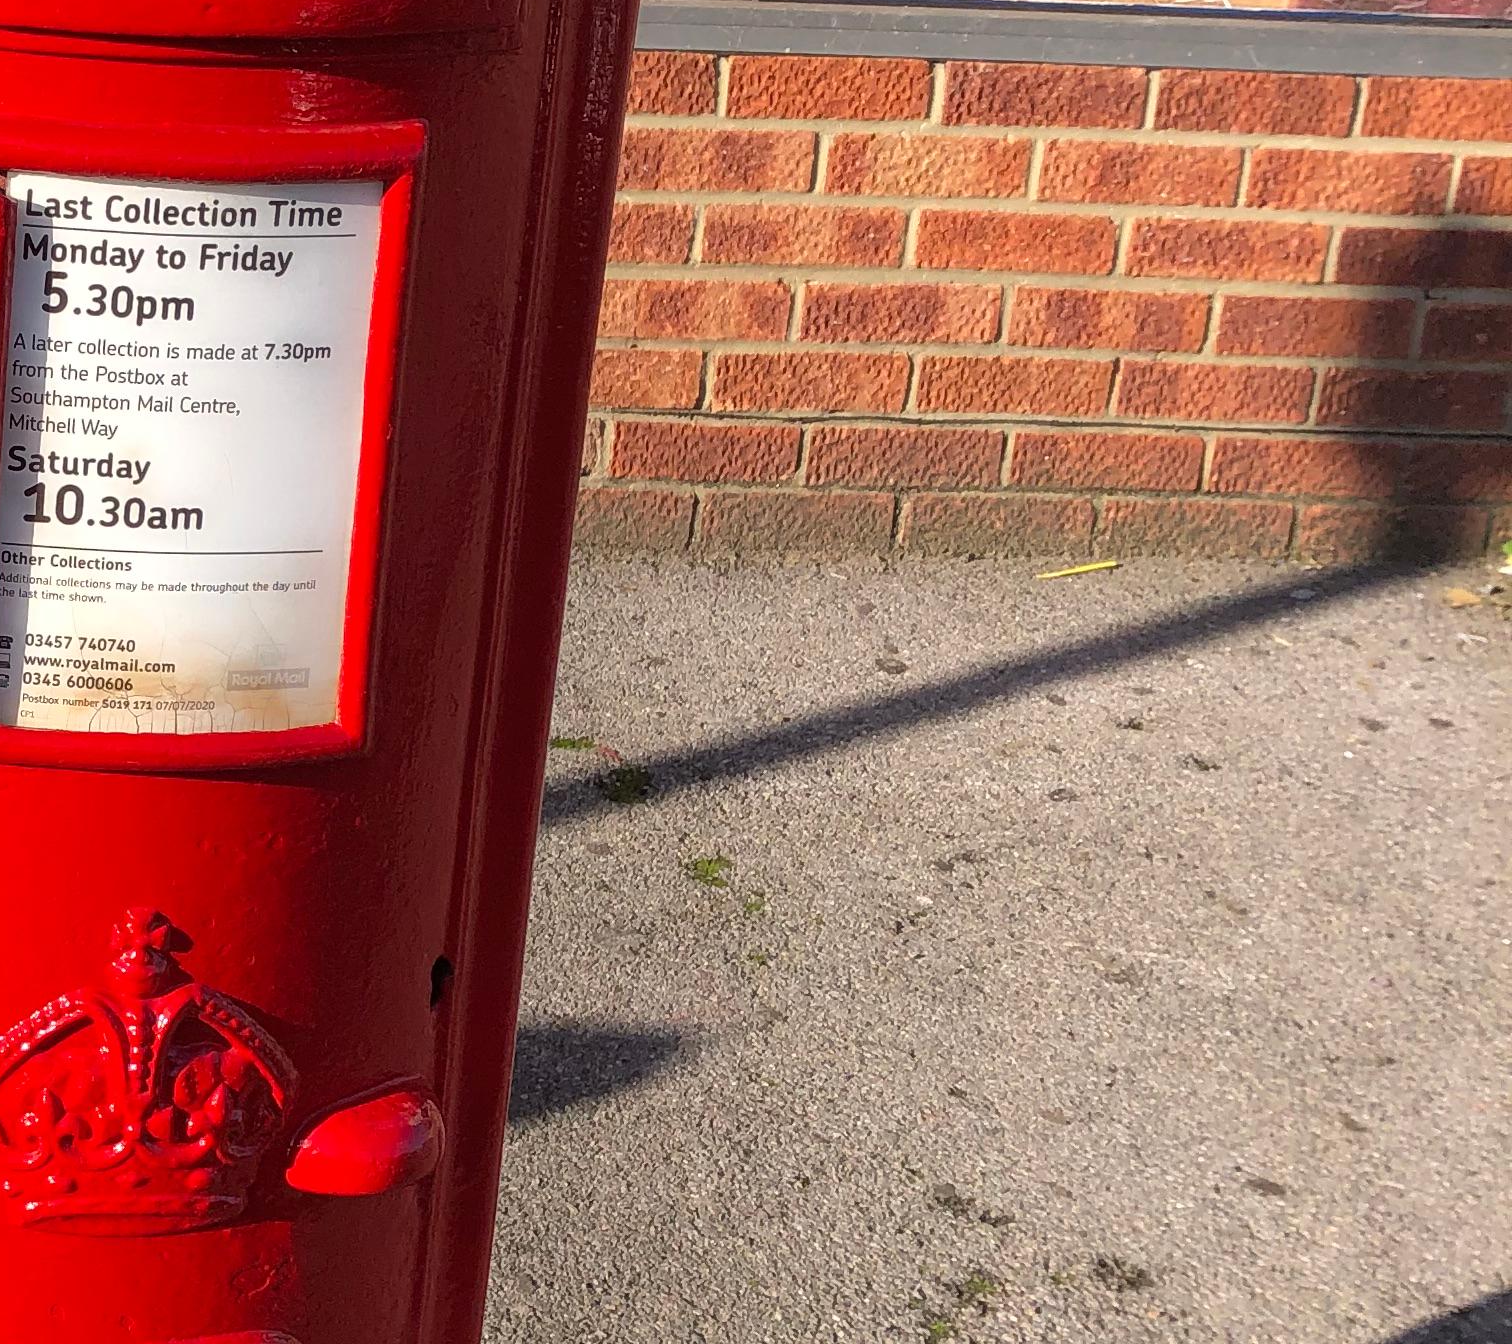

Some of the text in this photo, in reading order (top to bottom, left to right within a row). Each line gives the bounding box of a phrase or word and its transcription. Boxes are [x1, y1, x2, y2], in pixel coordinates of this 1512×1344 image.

[24, 189, 343, 228] Last Collection Time
[22, 233, 294, 277] Monday to Friday
[41, 271, 194, 326] 5.30pm
[13, 333, 331, 363] A later collection is made at 7.30pm
[12, 360, 189, 386] from the Postbox at
[10, 386, 240, 416] Southampton Mail Centre,
[9, 413, 118, 439] Mitchell Way
[7, 445, 151, 484] Saturday
[23, 482, 203, 531] 10.30am
[1, 550, 132, 571] Other Collections
[19, 587, 37, 599] last
[41, 590, 65, 601] time
[69, 592, 107, 604] shown.
[56, 577, 111, 590] collections
[115, 582, 137, 593] may
[141, 581, 154, 592] be
[158, 582, 187, 592] made
[191, 582, 249, 594] throughout
[252, 581, 269, 592] the
[272, 581, 290, 593] day
[293, 580, 316, 591] until
[25, 633, 136, 653] 03457 740740
[24, 655, 176, 673] www.royalmail.com
[22, 672, 134, 691] 0345 6000606
[231, 670, 306, 688] Royal Mail
[22, 693, 59, 705] Postbox
[62, 698, 100, 708] number
[133, 701, 152, 710] 171
[156, 700, 215, 711] 07/07/2020
